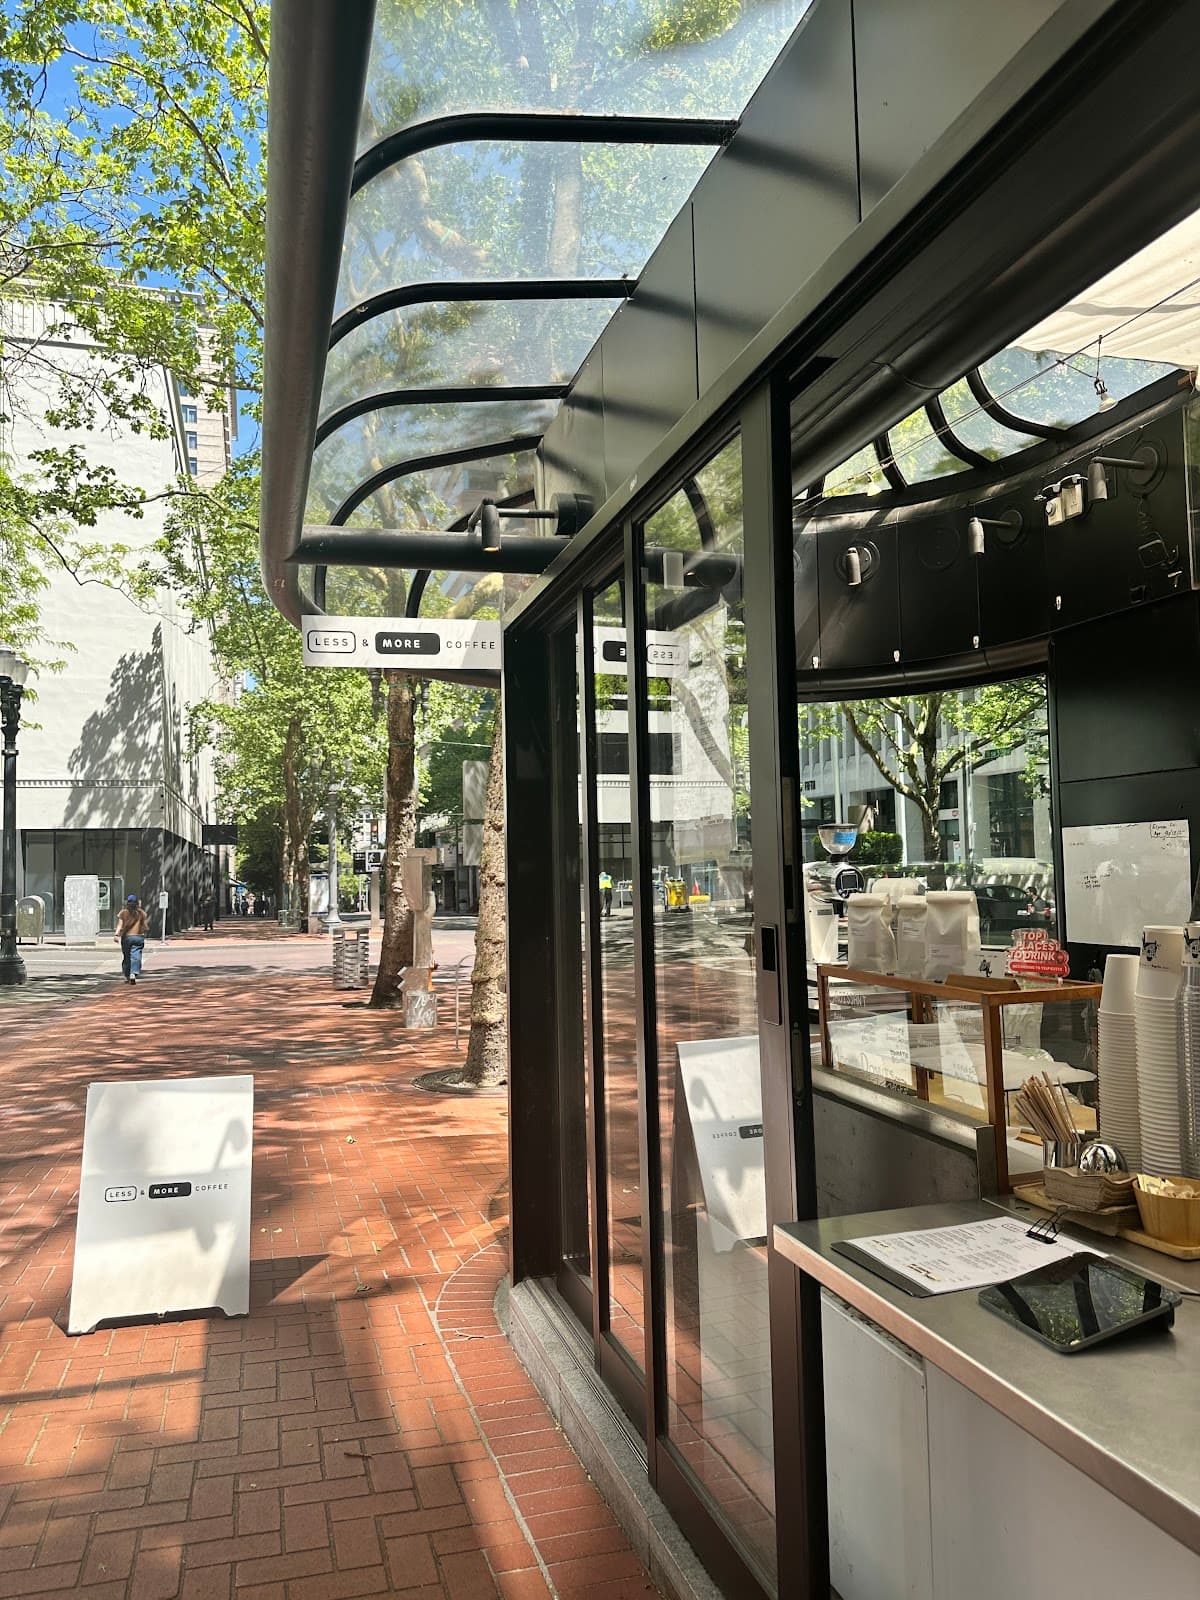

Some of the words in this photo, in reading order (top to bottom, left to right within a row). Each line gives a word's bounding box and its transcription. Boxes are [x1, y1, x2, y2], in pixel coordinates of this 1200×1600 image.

[315, 637, 348, 646] LESS
[362, 638, 369, 647] &
[382, 638, 421, 648] MORE
[446, 640, 496, 649] COFFEE
[1023, 950, 1056, 961] DRINK
[110, 1190, 132, 1198] LESS
[153, 1186, 179, 1195] MORE
[195, 1183, 228, 1192] COFFEE
